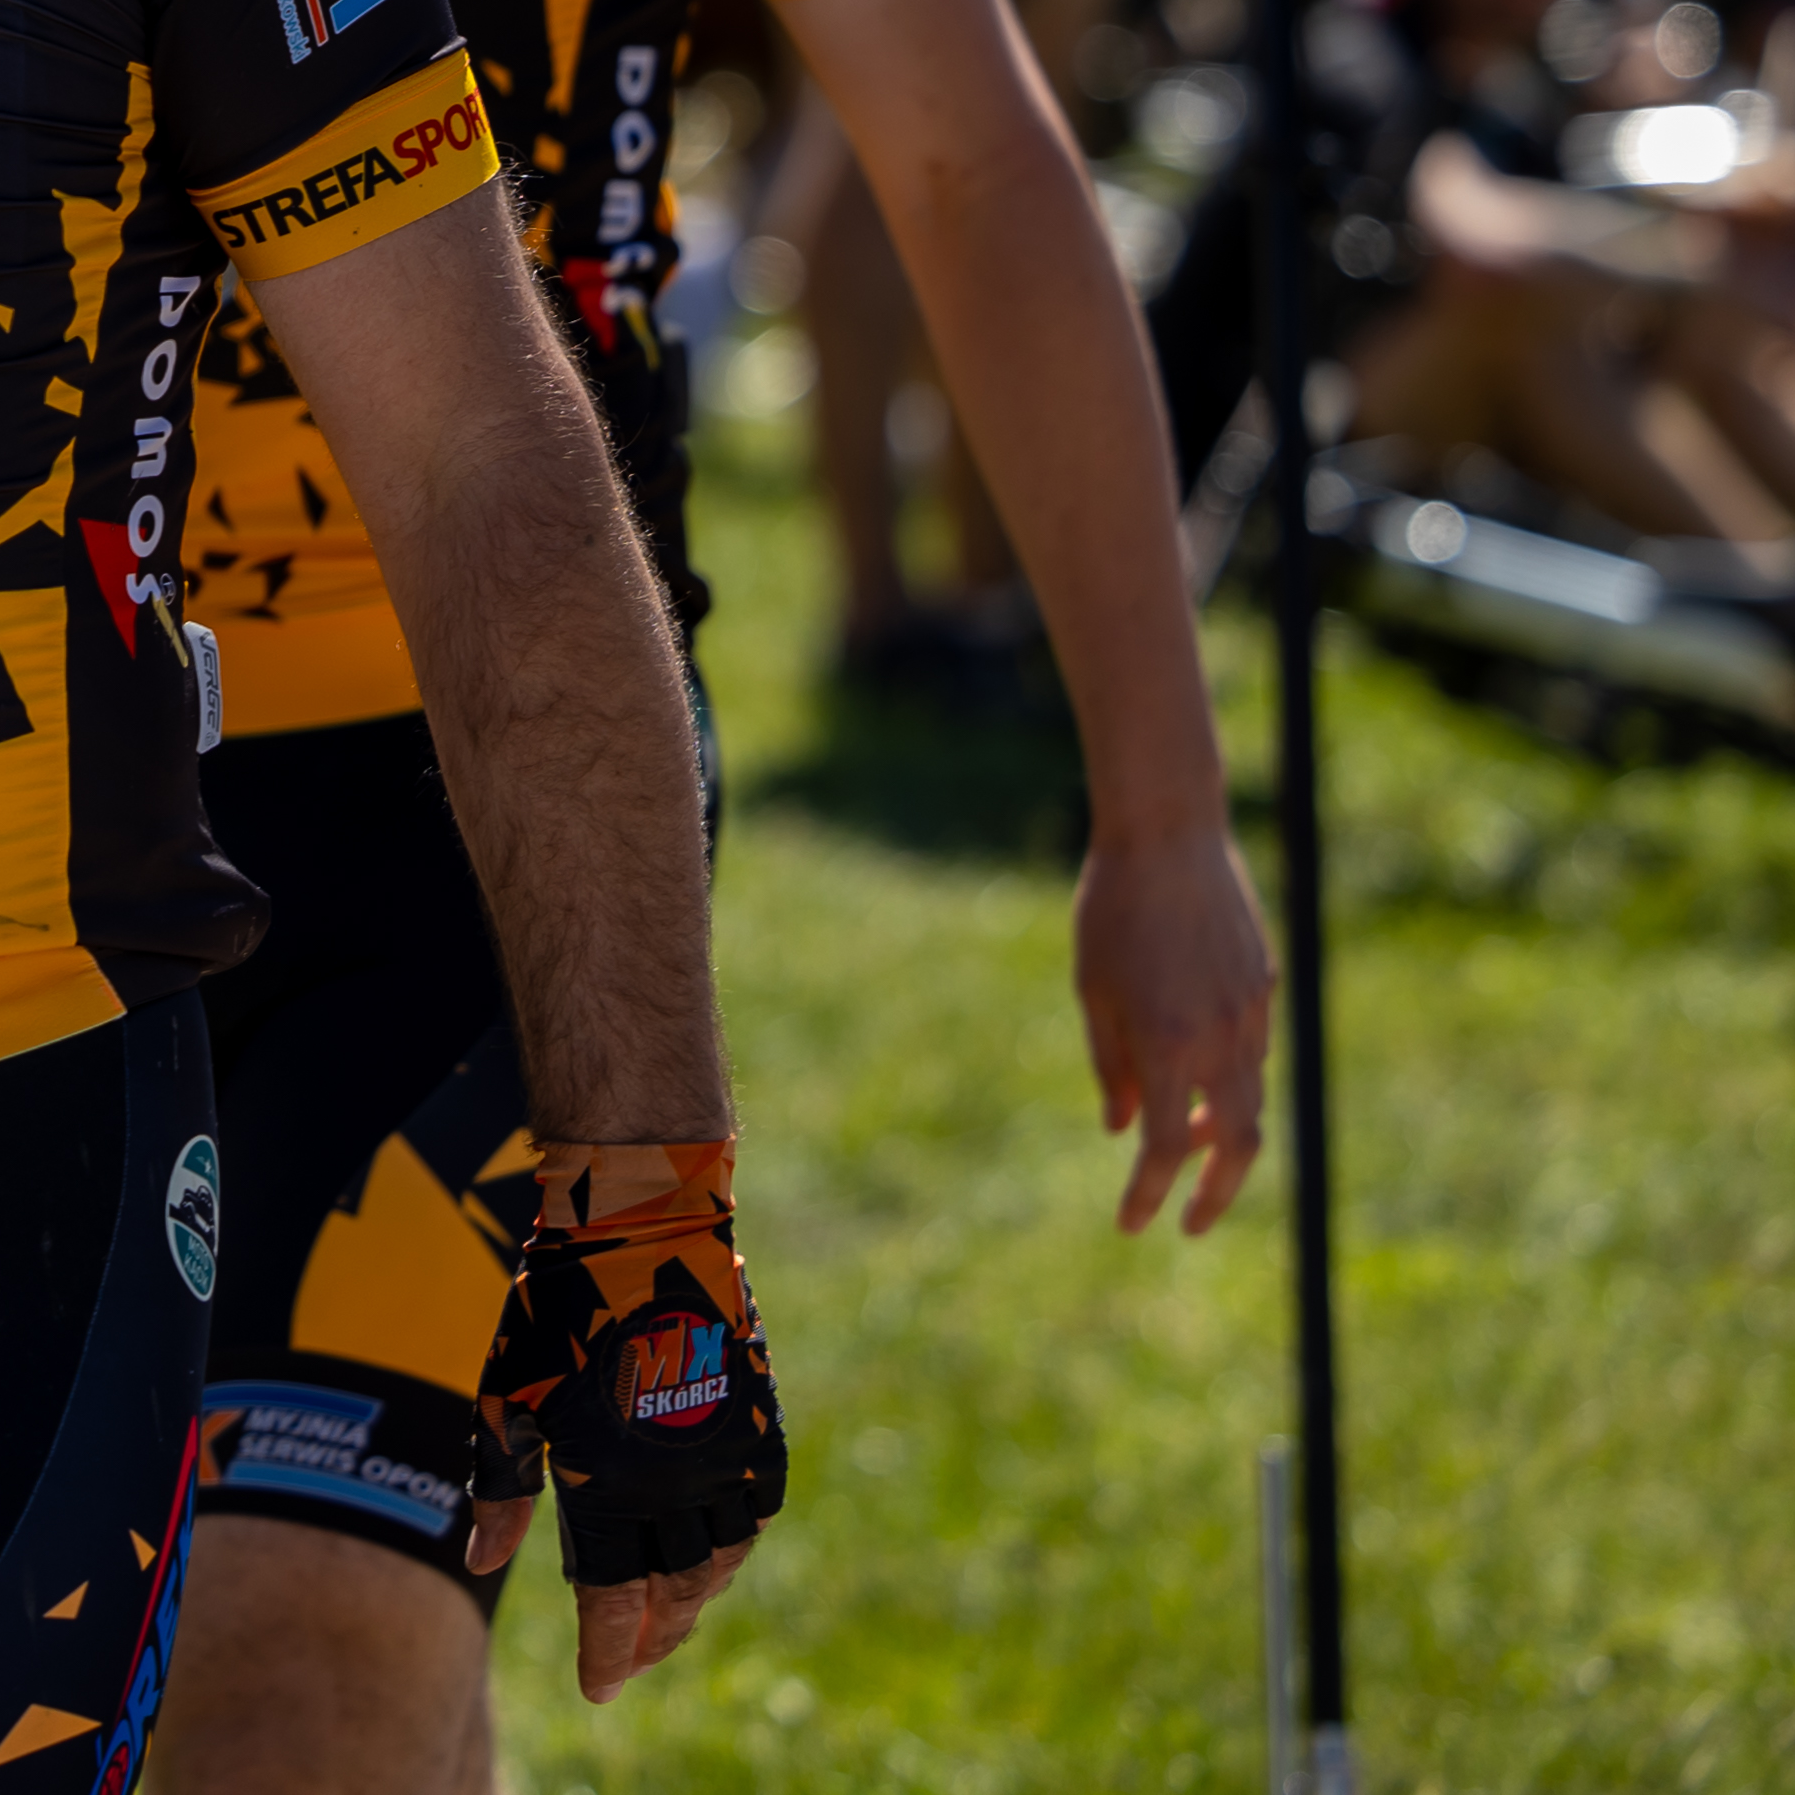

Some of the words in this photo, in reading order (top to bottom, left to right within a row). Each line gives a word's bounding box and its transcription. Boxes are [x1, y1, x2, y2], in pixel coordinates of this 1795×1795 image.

[614, 1319, 726, 1422] MX
[636, 1375, 729, 1420] SKÓRCZ
[360, 1454, 461, 1509] OPON
